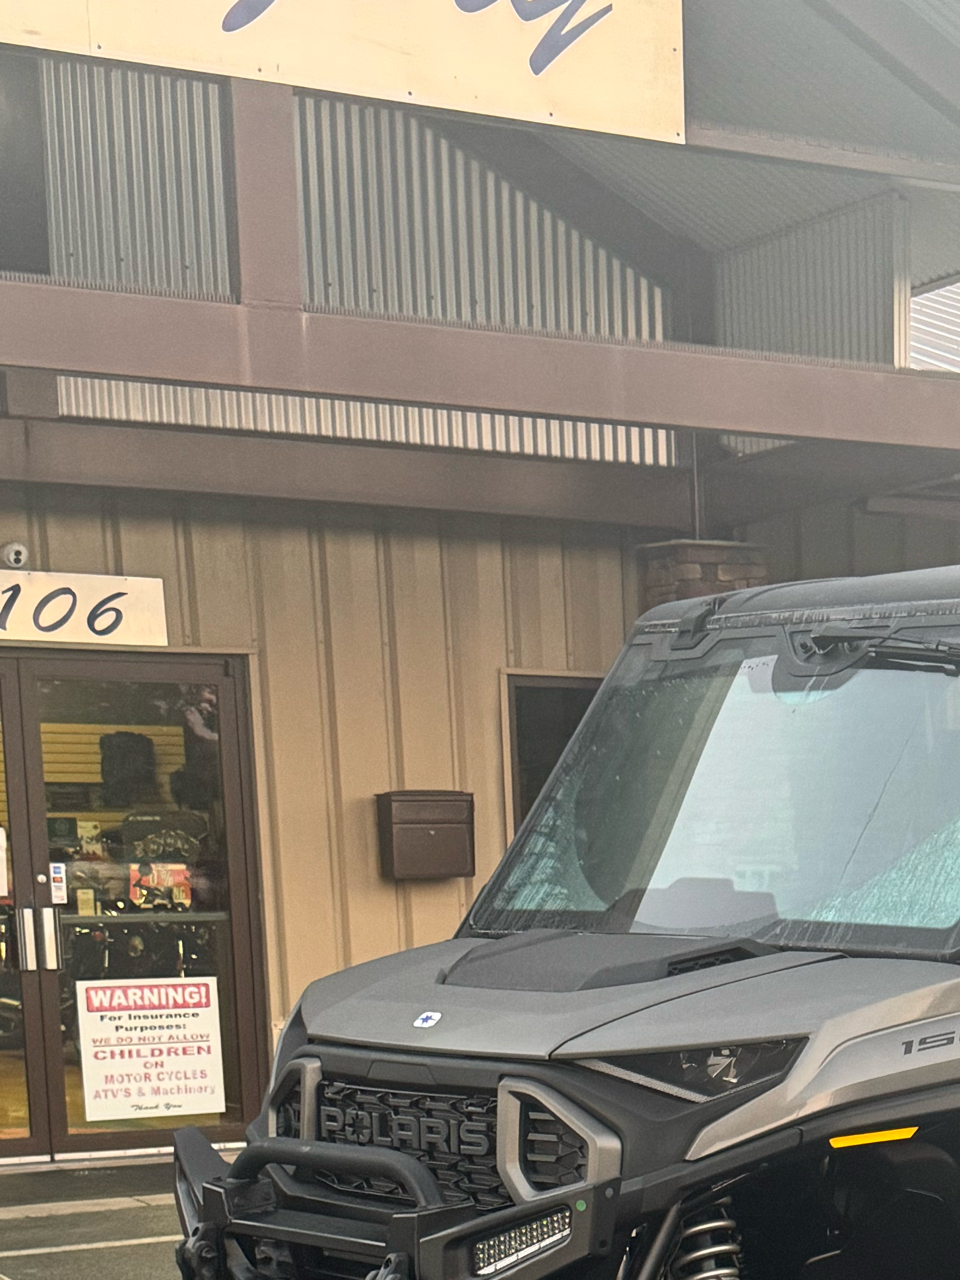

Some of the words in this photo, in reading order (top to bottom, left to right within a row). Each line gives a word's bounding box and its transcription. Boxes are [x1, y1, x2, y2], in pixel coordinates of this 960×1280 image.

[1, 584, 128, 636] 106
[89, 986, 206, 1008] WARNING!
[100, 1014, 123, 1022] For
[128, 1012, 200, 1020] Insurance
[115, 1023, 187, 1032] Purposes:
[167, 1033, 210, 1041] ALLOW
[93, 1045, 212, 1060] CHILDREN
[143, 1061, 164, 1069] ON
[104, 1073, 152, 1085] MOTOR
[156, 1069, 208, 1082] CYCLES
[93, 1087, 132, 1100] ATV'S
[137, 1086, 146, 1097] &
[150, 1084, 216, 1097] Machinery
[131, 1103, 159, 1111] Thank
[163, 1102, 183, 1111] You
[320, 1106, 490, 1156] POLARIS
